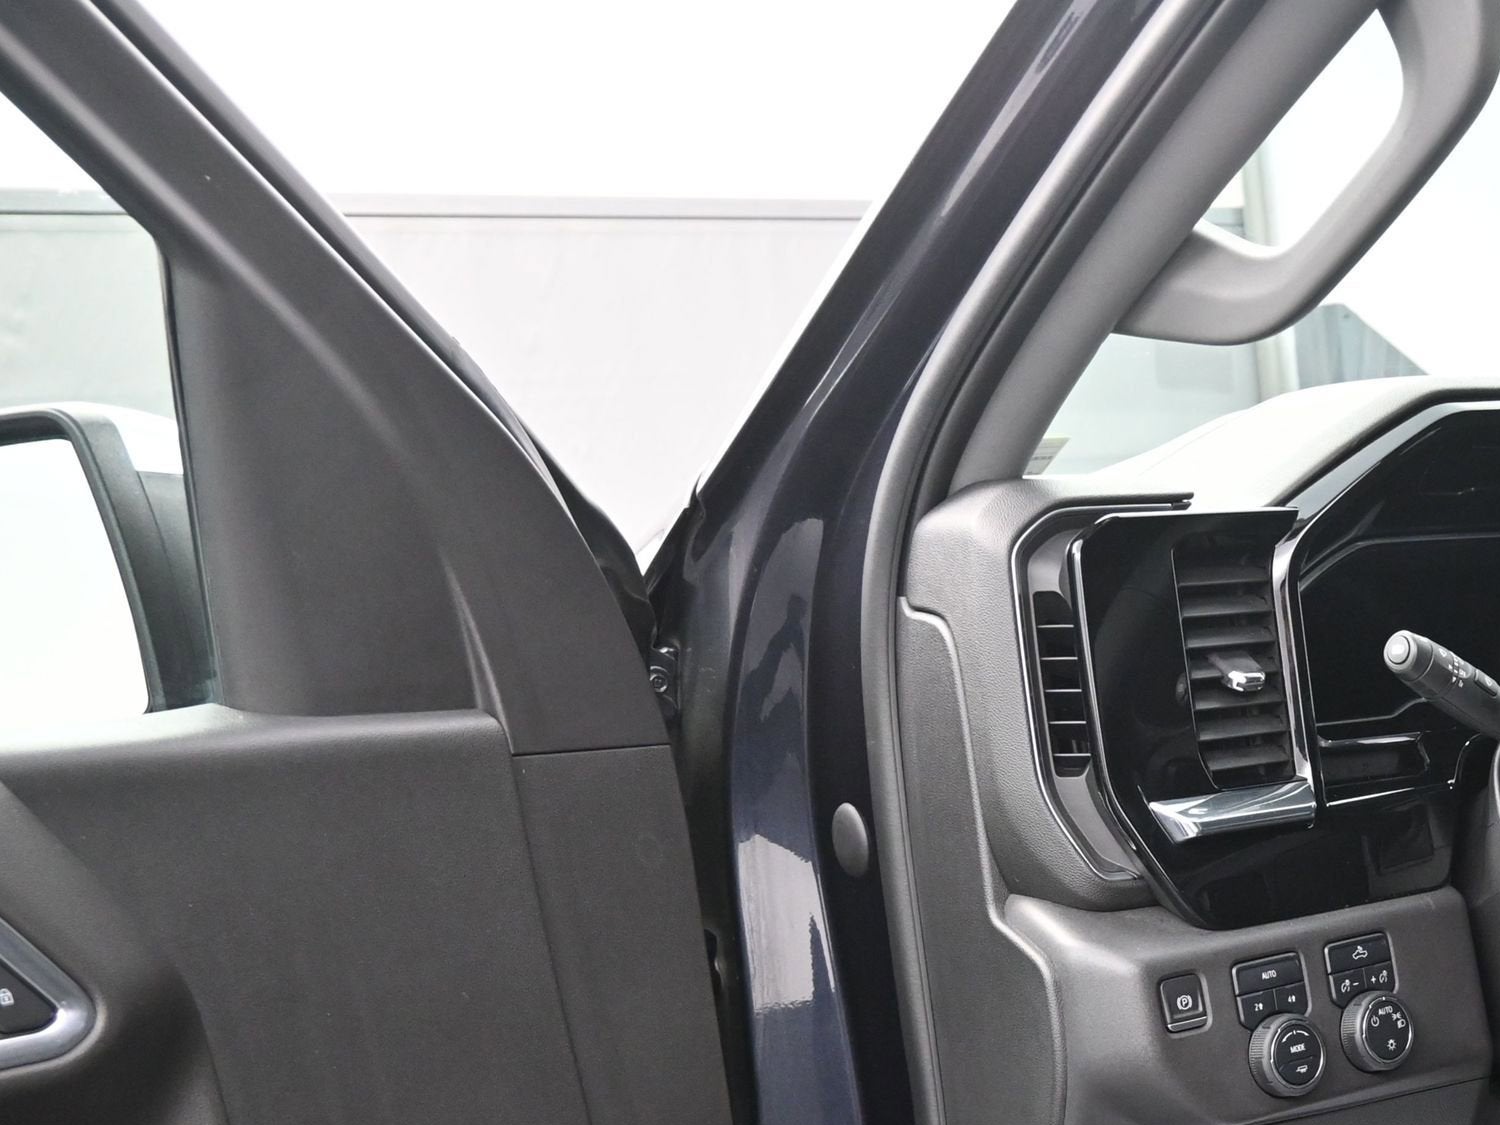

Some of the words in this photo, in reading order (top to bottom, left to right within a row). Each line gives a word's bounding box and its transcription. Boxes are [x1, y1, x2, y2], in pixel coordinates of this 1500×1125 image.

[1261, 969, 1277, 980] AUTO
[1378, 1005, 1393, 1016] AUTO
[1289, 1043, 1306, 1054] MODE
